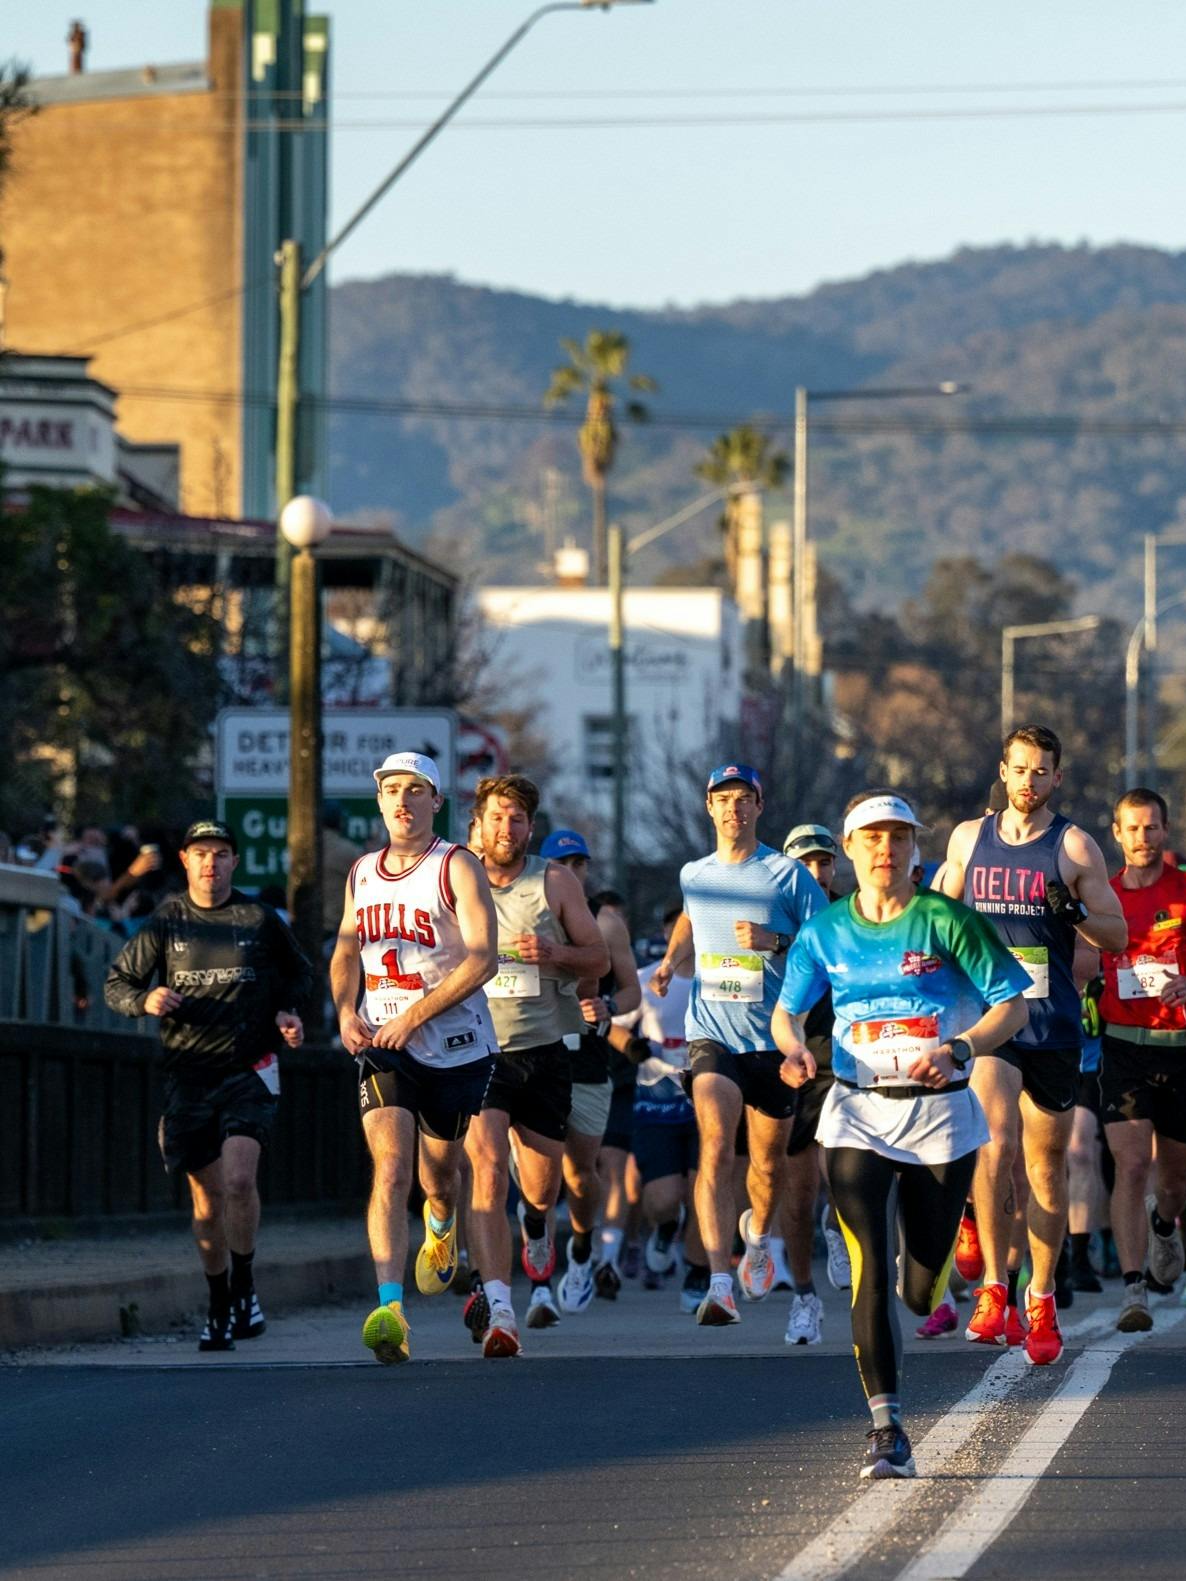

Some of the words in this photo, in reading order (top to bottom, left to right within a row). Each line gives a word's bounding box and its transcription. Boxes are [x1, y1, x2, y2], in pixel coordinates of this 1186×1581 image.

[237, 730, 348, 753] DETR
[357, 734, 396, 751] FOR
[973, 866, 1045, 902] DELTA
[1008, 903, 1045, 916] PROJECT
[495, 975, 517, 989] 427
[719, 980, 742, 993] 478
[1140, 976, 1156, 988] 82
[384, 1002, 398, 1015] 111
[893, 1055, 899, 1072] 1
